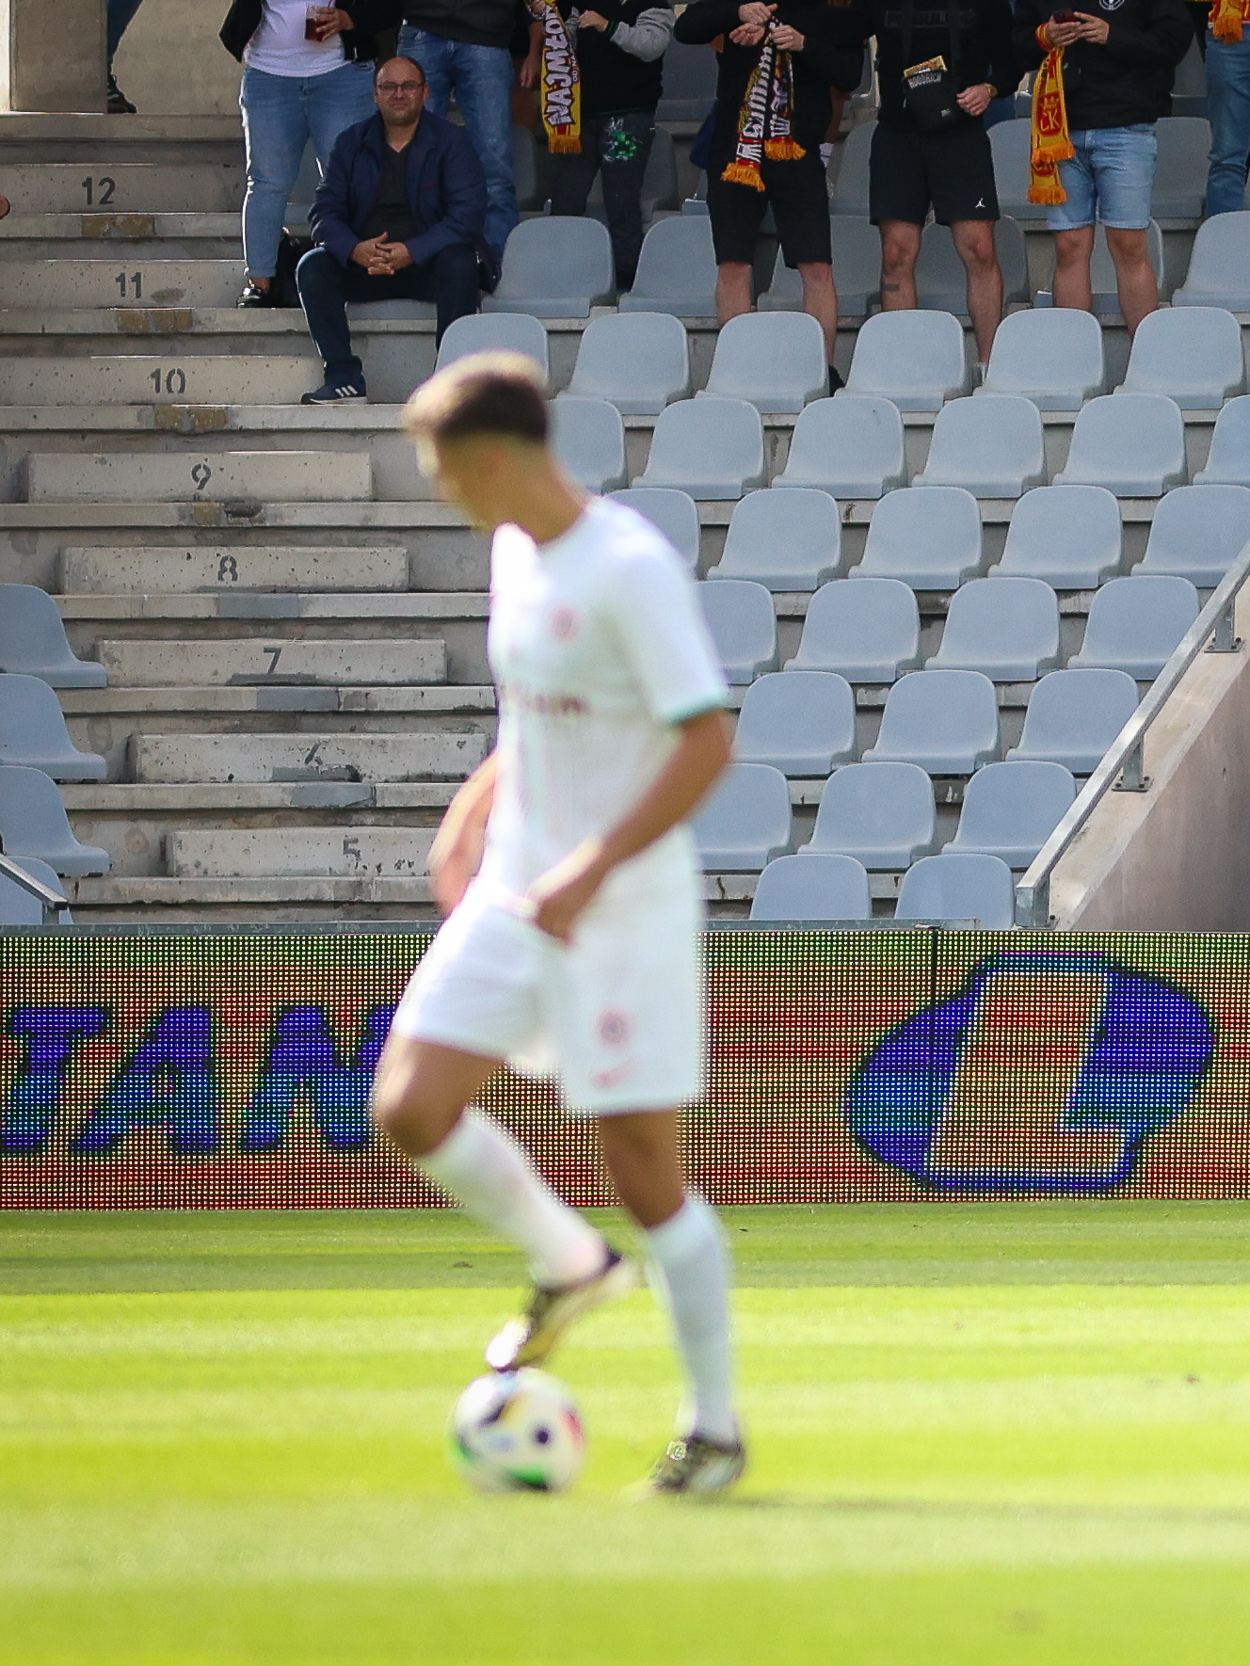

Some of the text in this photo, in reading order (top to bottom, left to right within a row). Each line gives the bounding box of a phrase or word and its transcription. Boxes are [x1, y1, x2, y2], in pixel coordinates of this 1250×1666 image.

[82, 177, 115, 205] 12
[115, 272, 142, 299] 11
[151, 368, 186, 394] 10
[191, 463, 211, 490] 9
[217, 554, 238, 582] 8
[263, 647, 282, 674] 7
[343, 838, 360, 862] 5
